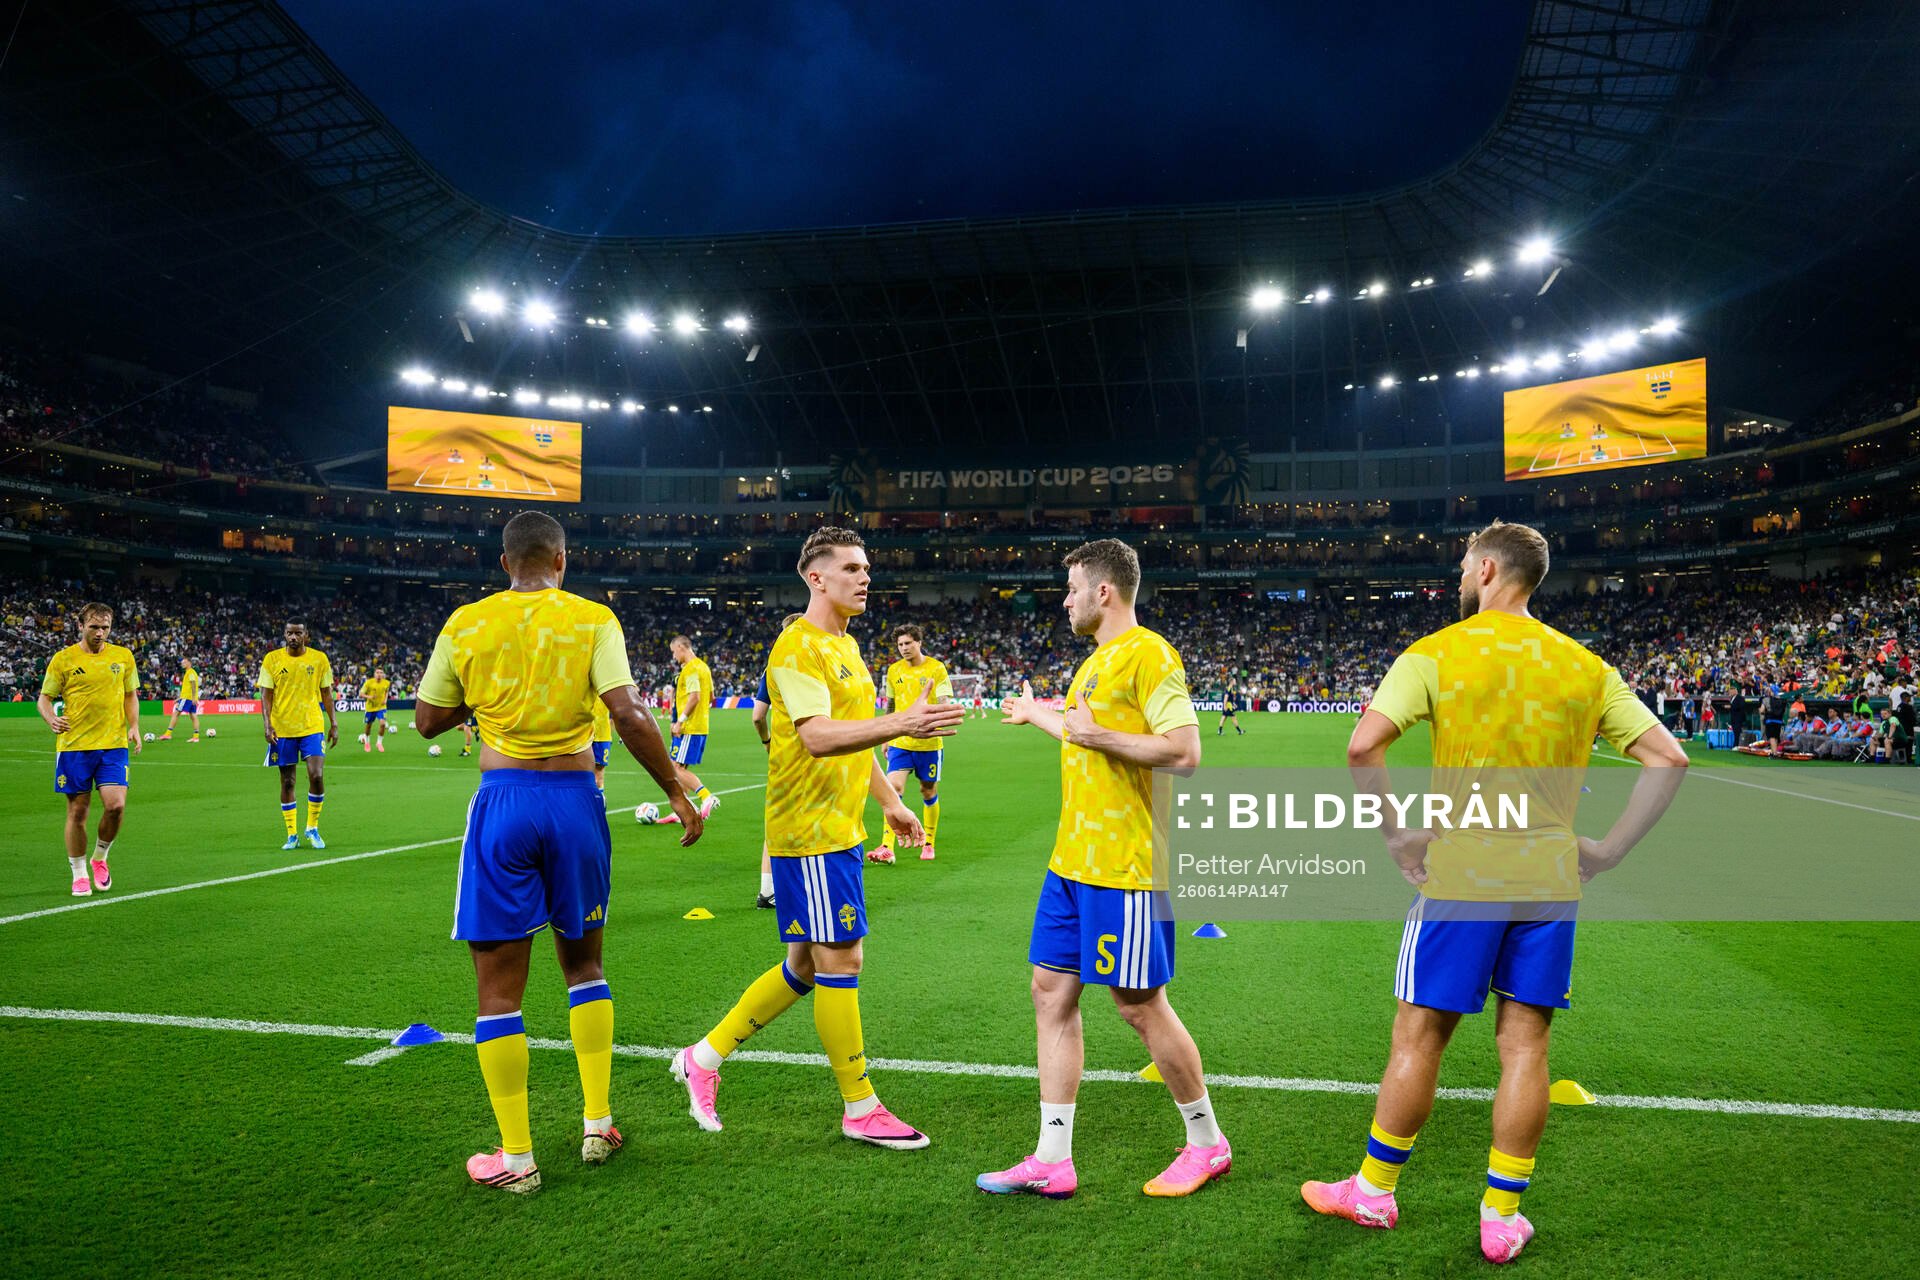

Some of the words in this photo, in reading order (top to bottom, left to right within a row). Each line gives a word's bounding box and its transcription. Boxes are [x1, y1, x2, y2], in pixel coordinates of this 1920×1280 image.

[898, 470, 947, 489] FIFA
[949, 469, 1034, 488] WORLD
[1038, 468, 1087, 487] CUP
[1090, 464, 1174, 486] 2026
[1847, 525, 1896, 540] MONTERREY
[174, 552, 232, 564] MONTERREY
[1197, 570, 1257, 579] MONTERREY
[218, 703, 235, 713] zero
[235, 703, 256, 713] sugar
[1287, 700, 1362, 713] motorola
[928, 763, 937, 778] 3
[1095, 934, 1118, 975] 5
